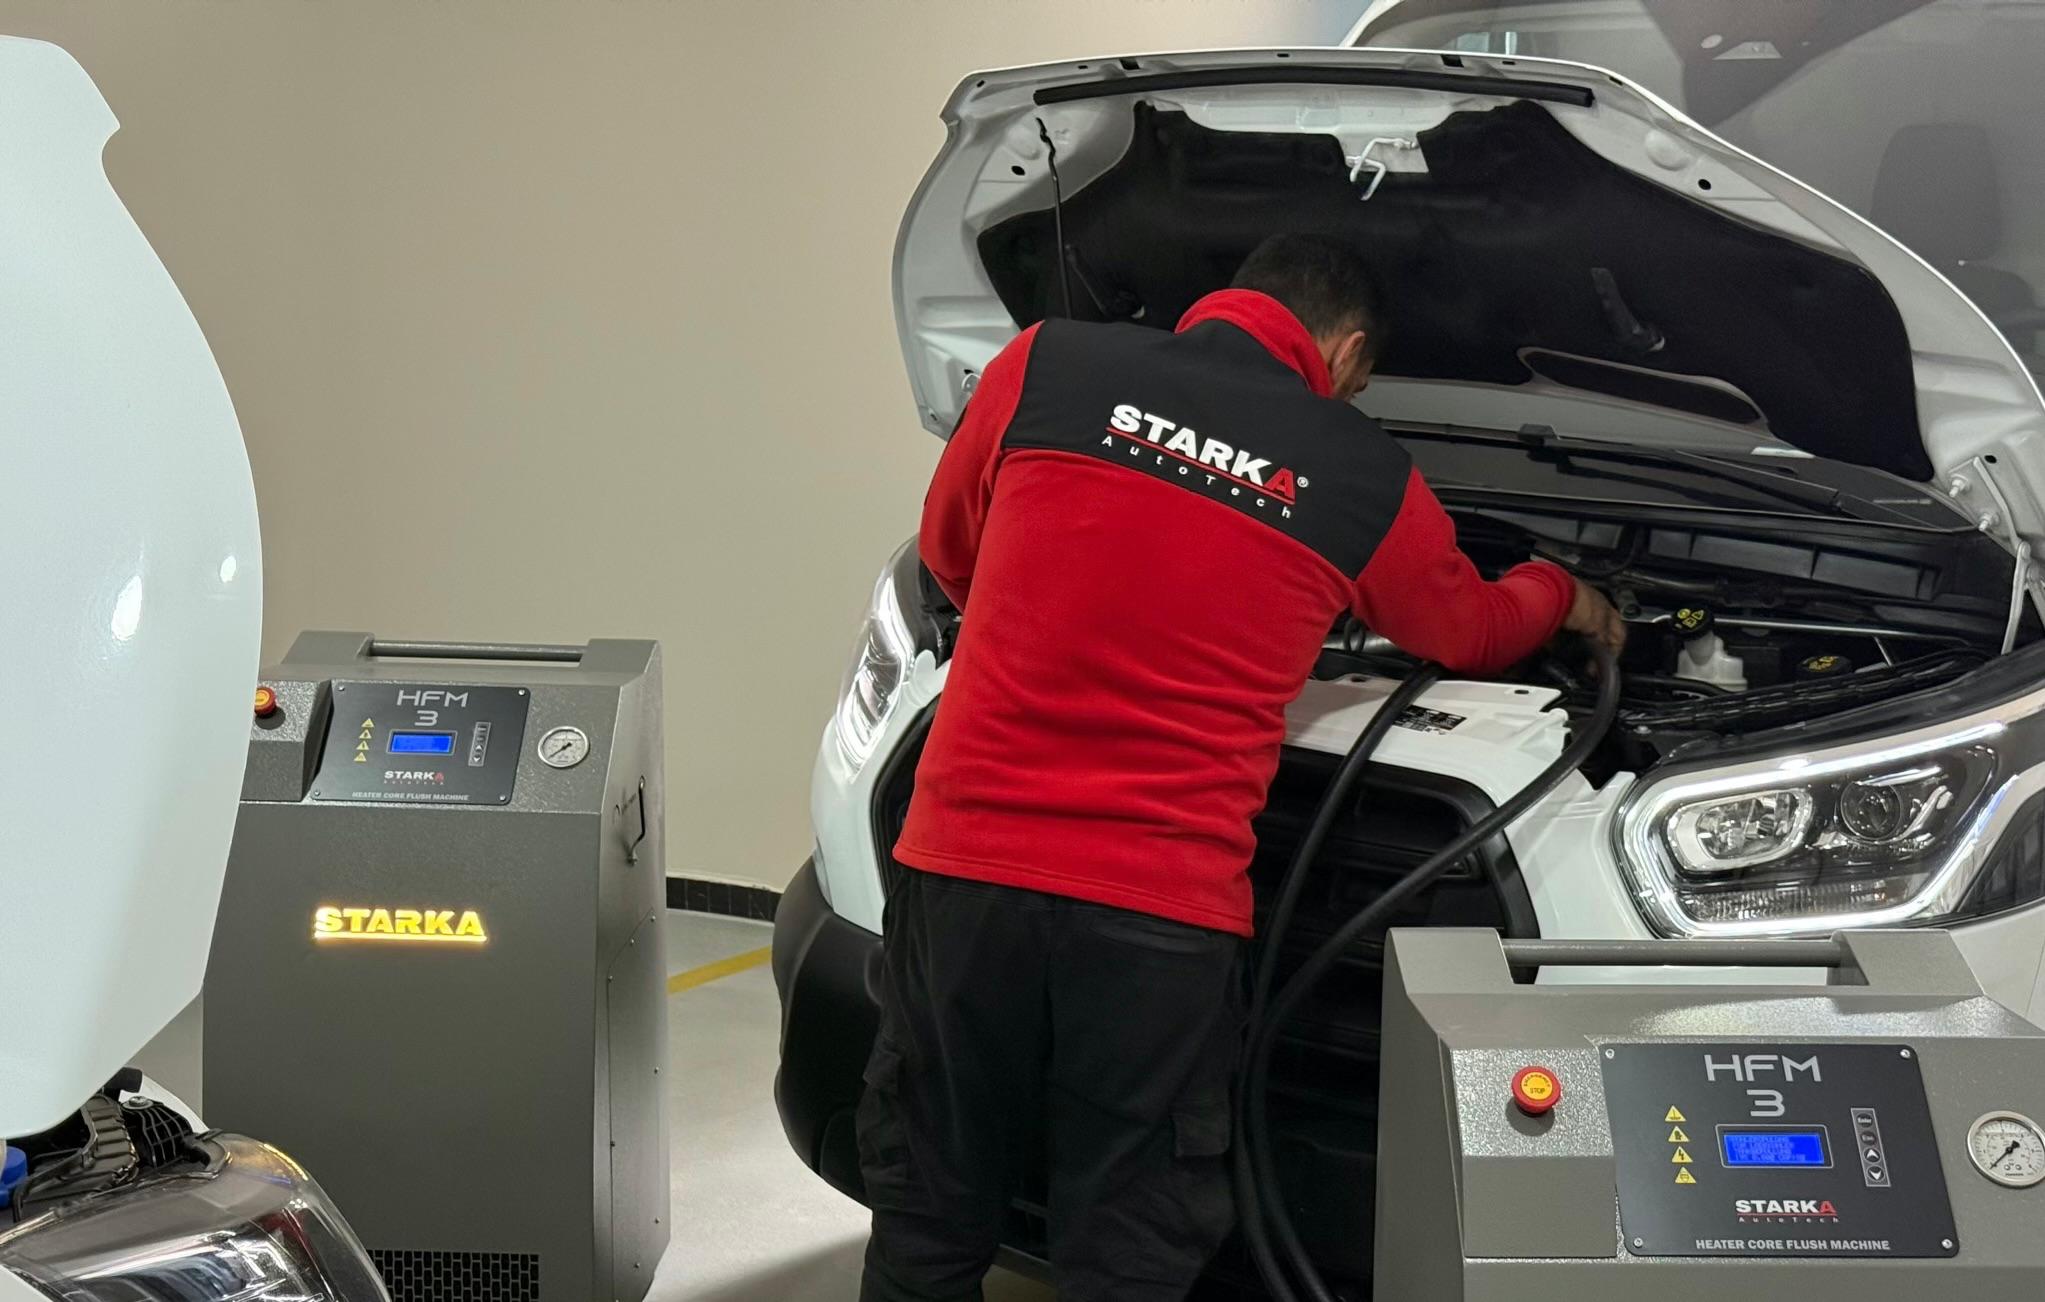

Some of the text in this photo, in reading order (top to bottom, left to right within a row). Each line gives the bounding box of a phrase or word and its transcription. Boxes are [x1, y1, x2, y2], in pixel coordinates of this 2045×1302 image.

[396, 689, 469, 708] HFM
[414, 710, 439, 727] 3
[383, 770, 445, 782] STARKA
[314, 906, 486, 937] STARKA
[1703, 1054, 1822, 1082] HFM
[1529, 1087, 1546, 1095] STOP
[1746, 1089, 1786, 1117] 3
[1735, 1199, 1837, 1214] STARKA
[1695, 1239, 1891, 1251] HEATER CORE FLUSH MACHINE
